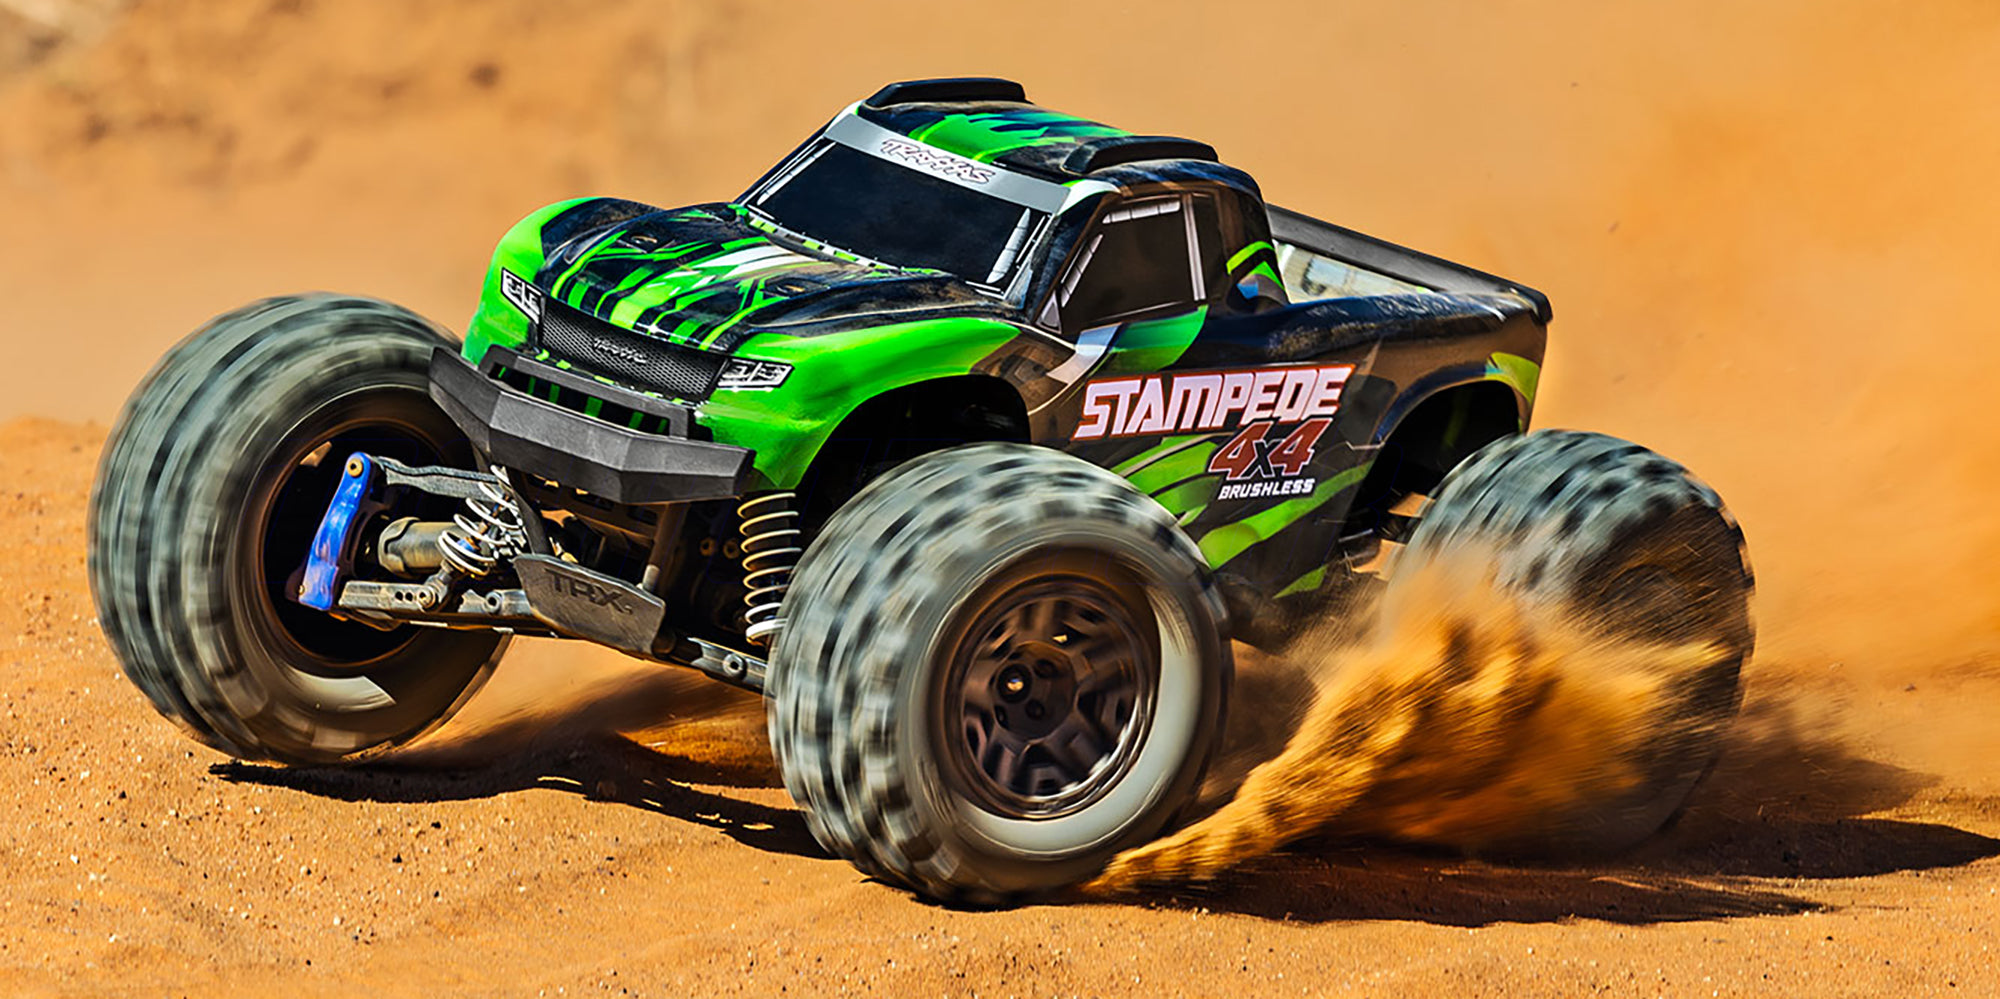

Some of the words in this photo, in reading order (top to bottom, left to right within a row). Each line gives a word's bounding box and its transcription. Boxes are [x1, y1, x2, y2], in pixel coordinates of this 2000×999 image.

[880, 139, 996, 184] TRAXXAS
[1071, 364, 1355, 440] STAMPEDE
[1218, 478, 1316, 500] BRUSHLESS
